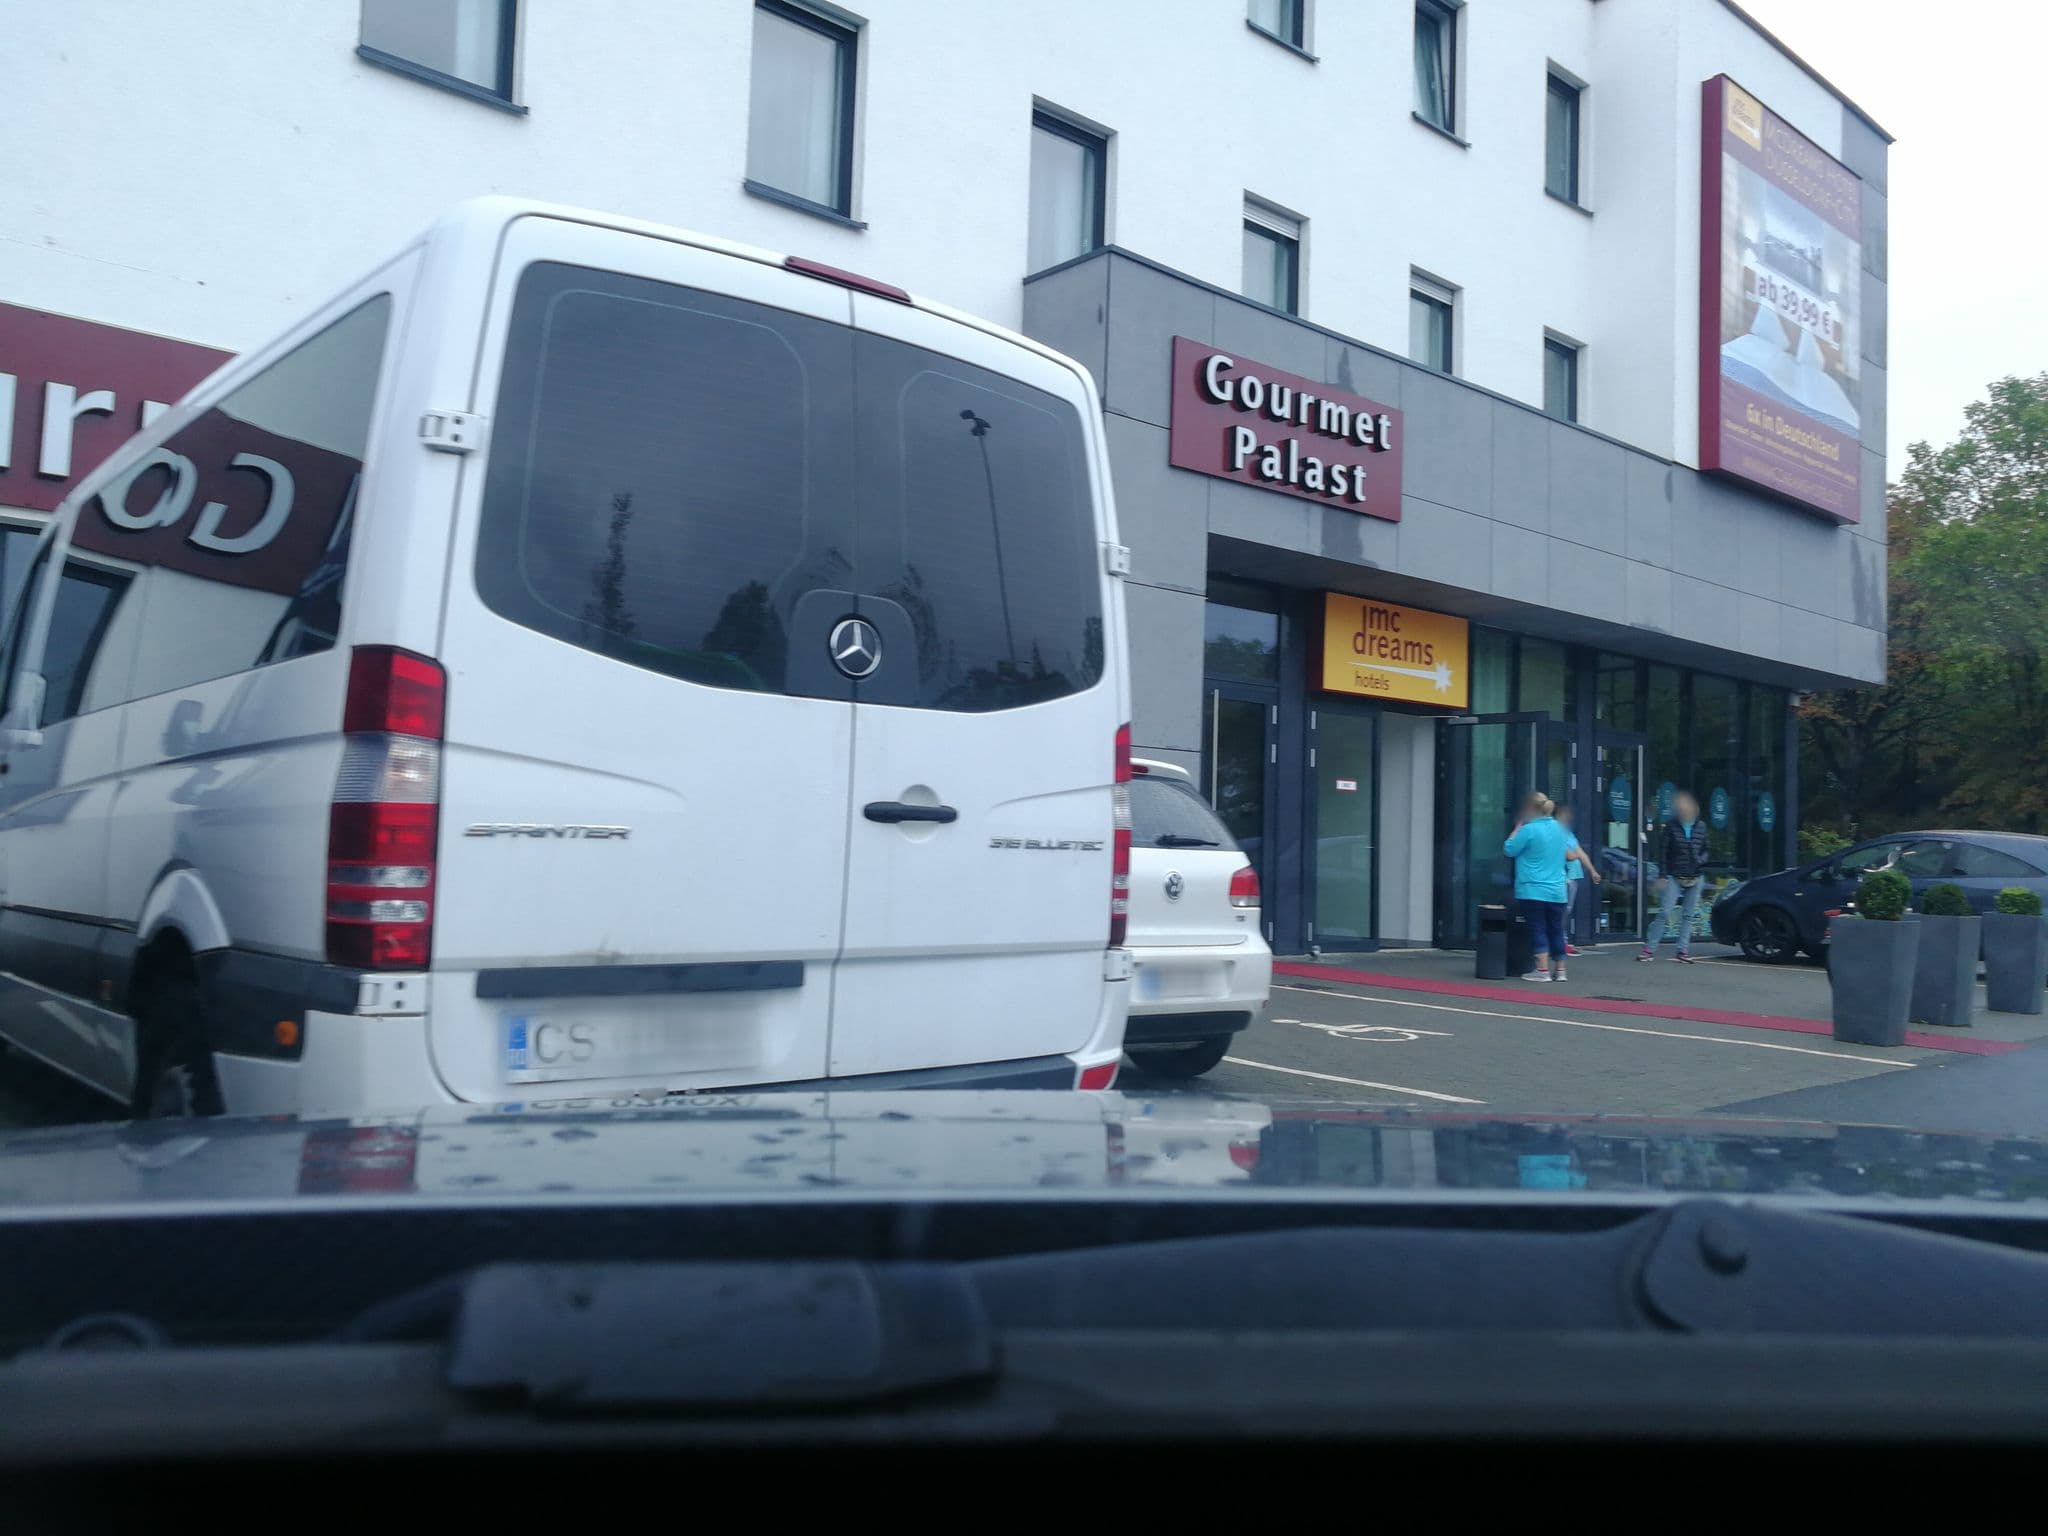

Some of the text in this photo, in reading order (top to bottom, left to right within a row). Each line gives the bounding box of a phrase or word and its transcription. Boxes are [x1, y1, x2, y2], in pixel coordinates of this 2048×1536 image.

[1206, 354, 1391, 450] Gourmet
[1234, 425, 1366, 502] Palast
[1353, 610, 1434, 666] dreams
[1355, 671, 1390, 691] hotels
[464, 822, 632, 841] SPRINTER
